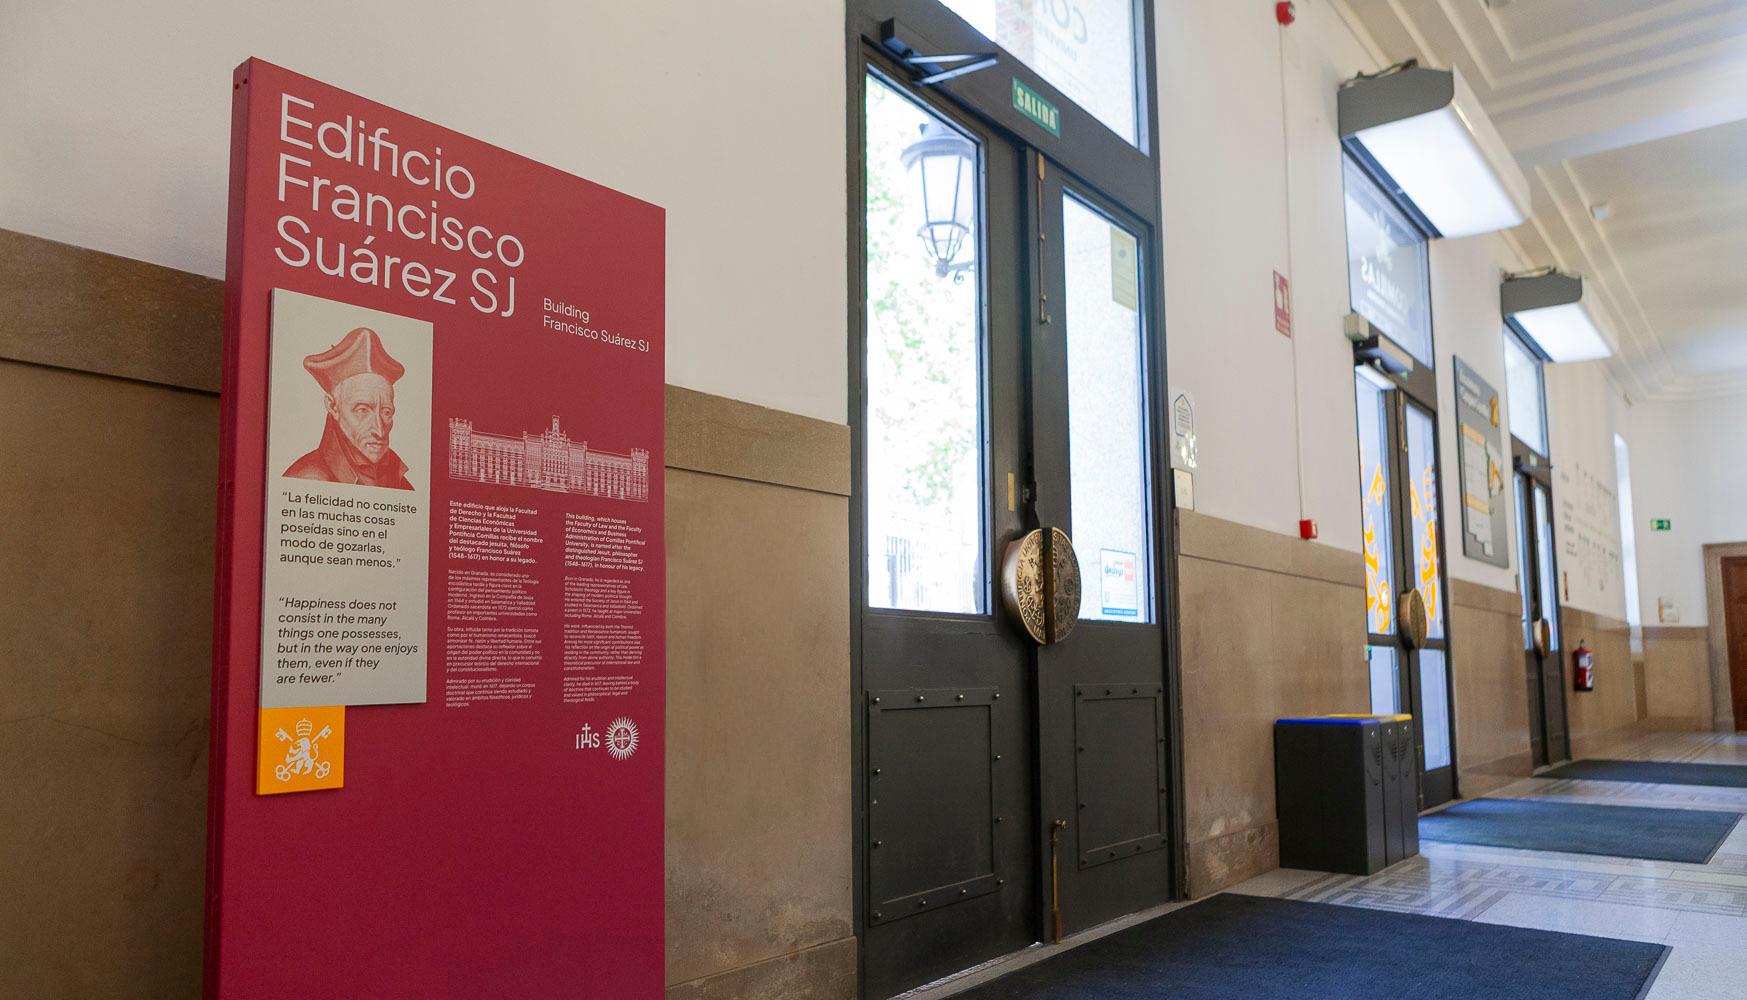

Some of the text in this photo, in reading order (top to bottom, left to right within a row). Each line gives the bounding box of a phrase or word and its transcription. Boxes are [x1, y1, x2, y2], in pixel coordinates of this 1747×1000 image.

[1016, 87, 1056, 130] SALIDA
[280, 92, 476, 199] Edificio
[278, 153, 525, 268] Francisco
[274, 215, 516, 317] Suárez SJ
[543, 297, 590, 323] Building
[543, 314, 650, 353] Francisco Suárez SJ
[305, 493, 354, 508] felicidad
[357, 501, 370, 510] no
[373, 499, 417, 514] consiste
[463, 502, 483, 510] edificio
[496, 505, 509, 514] aloja
[516, 507, 537, 515] Facultad
[281, 507, 395, 526] en las muchas cosas
[459, 509, 481, 517] Derecho
[493, 512, 516, 520] Facultad
[459, 516, 481, 524] Ciencias
[281, 521, 388, 539] poseídas sino en el
[454, 523, 492, 534] Empresariales
[507, 528, 537, 536] Universidad
[572, 527, 597, 535] Economics
[575, 521, 591, 529] Faculty
[626, 525, 642, 534] Faculty
[449, 530, 475, 538] Pontificia
[476, 532, 499, 540] Comillas
[565, 533, 599, 541] Administration
[281, 536, 385, 556] modo de gozarlas,
[459, 538, 488, 546] destacado
[565, 547, 596, 556] distinguished
[612, 550, 638, 559] philosopher
[575, 554, 600, 563] theologian
[280, 554, 324, 567] aunque
[327, 556, 353, 566] sean
[518, 557, 536, 565] legado.
[349, 598, 376, 610] does
[379, 599, 397, 610] not
[278, 611, 388, 627] consist in the many
[278, 627, 401, 641] things one possesses,
[278, 642, 418, 656] but in the way one enjoys
[277, 657, 380, 671] them, even if they
[277, 675, 296, 684] are
